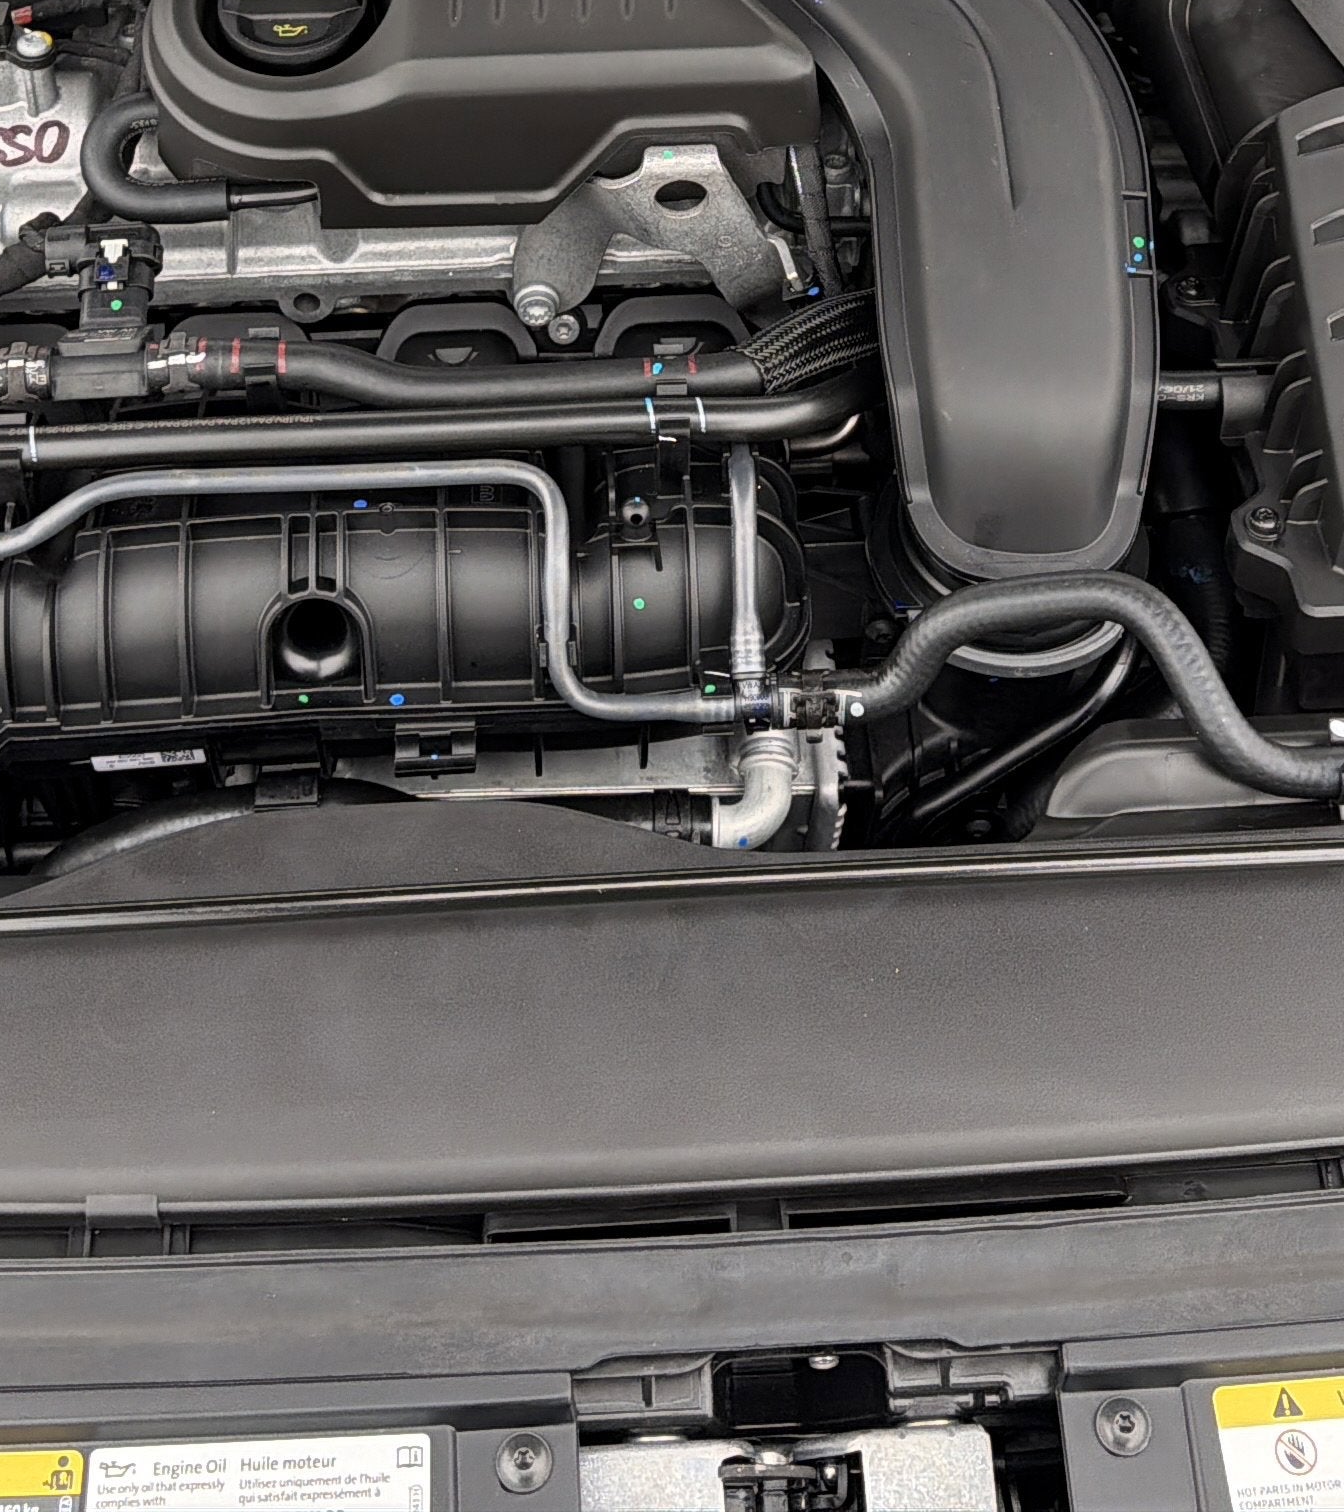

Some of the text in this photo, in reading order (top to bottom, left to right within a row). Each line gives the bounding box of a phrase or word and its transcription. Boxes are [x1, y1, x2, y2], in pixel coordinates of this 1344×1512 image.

[153, 1454, 337, 1479] Engine Oil Huile moteur
[97, 1484, 117, 1496] Use
[117, 1481, 140, 1497] only
[155, 1479, 177, 1493] that
[178, 1477, 225, 1493] expressly
[239, 1478, 278, 1490] Utilisez
[279, 1475, 342, 1490] uniquement
[344, 1473, 358, 1485] de
[95, 1496, 167, 1510] complies with
[239, 1493, 256, 1506] qui
[257, 1489, 298, 1503] satisfait
[299, 1486, 373, 1503] expressément
